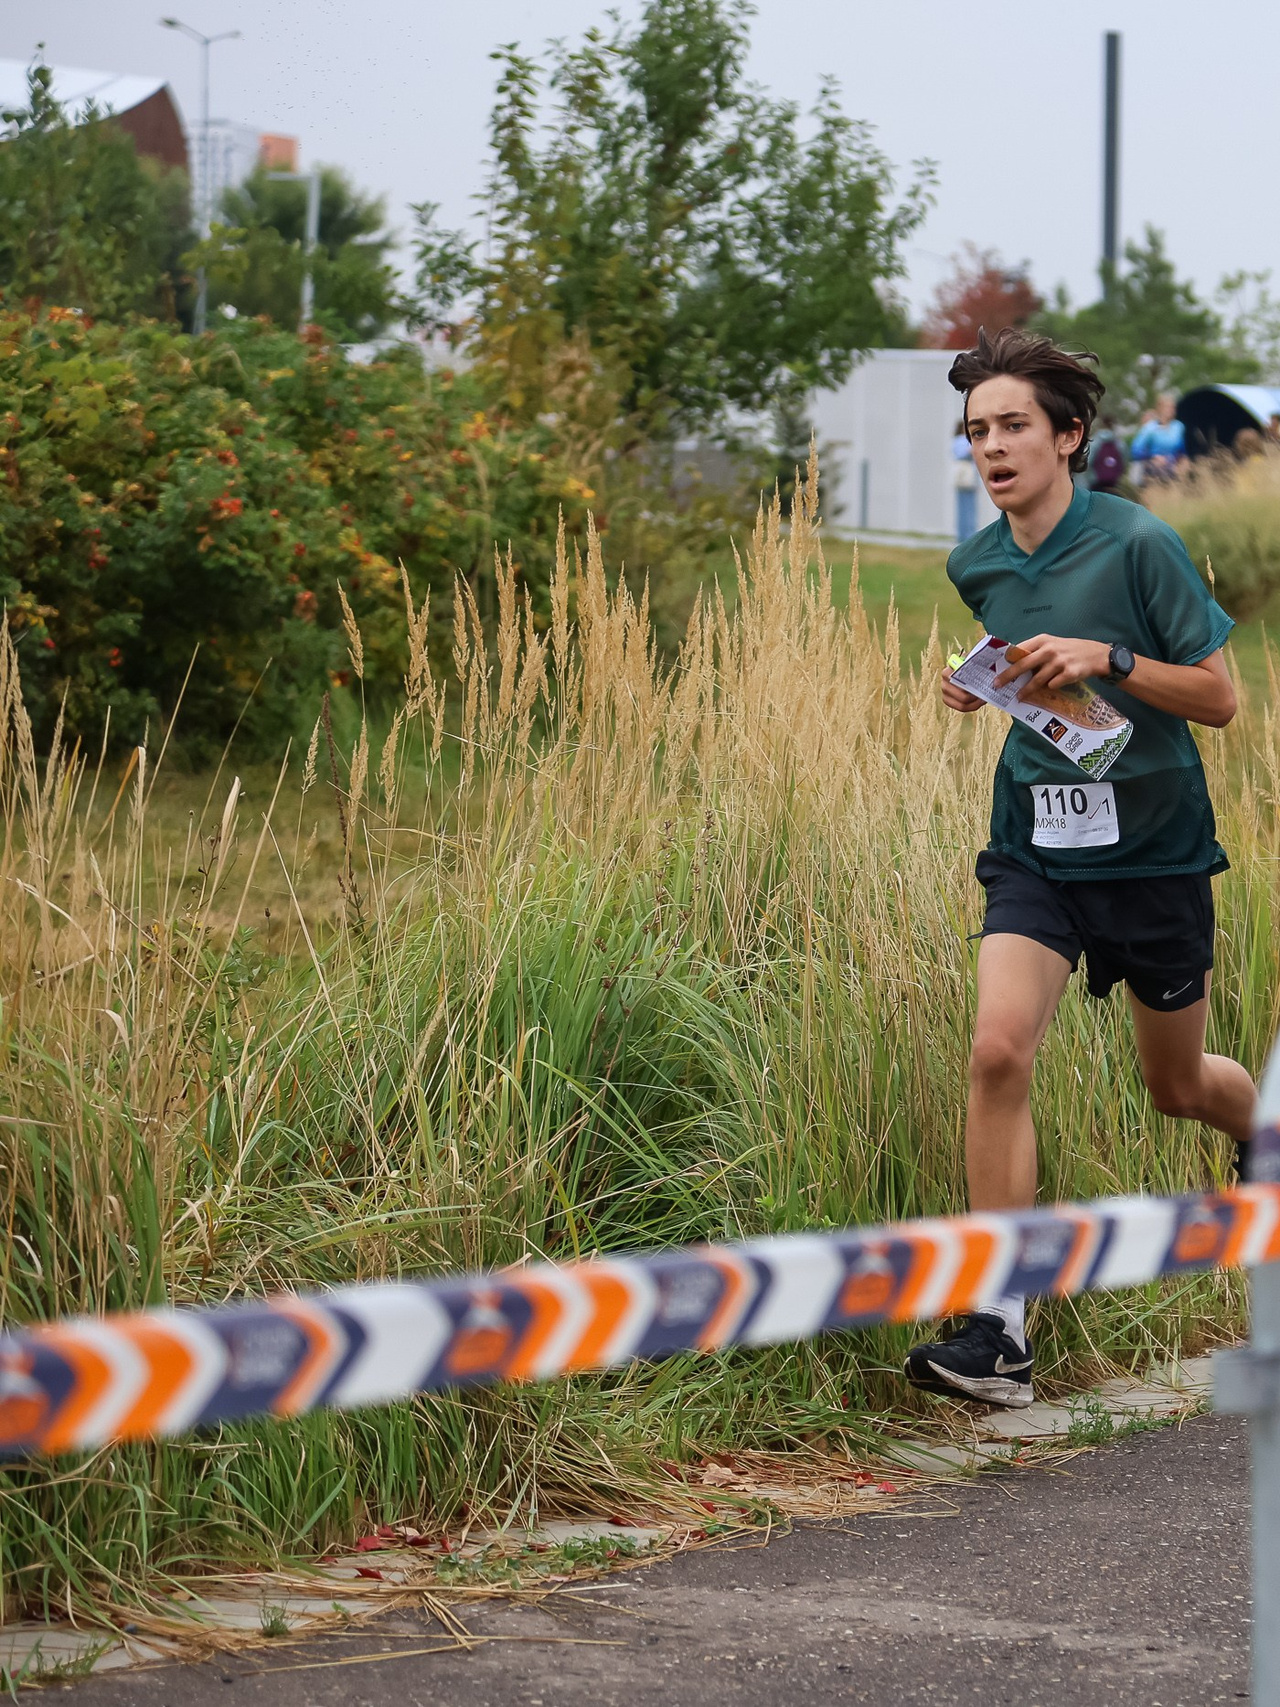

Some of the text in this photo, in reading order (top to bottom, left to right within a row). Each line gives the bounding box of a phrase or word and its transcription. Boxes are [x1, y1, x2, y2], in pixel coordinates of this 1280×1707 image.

[1040, 787, 1088, 815] 110
[1102, 797, 1110, 815] 1
[1035, 817, 1067, 829] МЖ18
